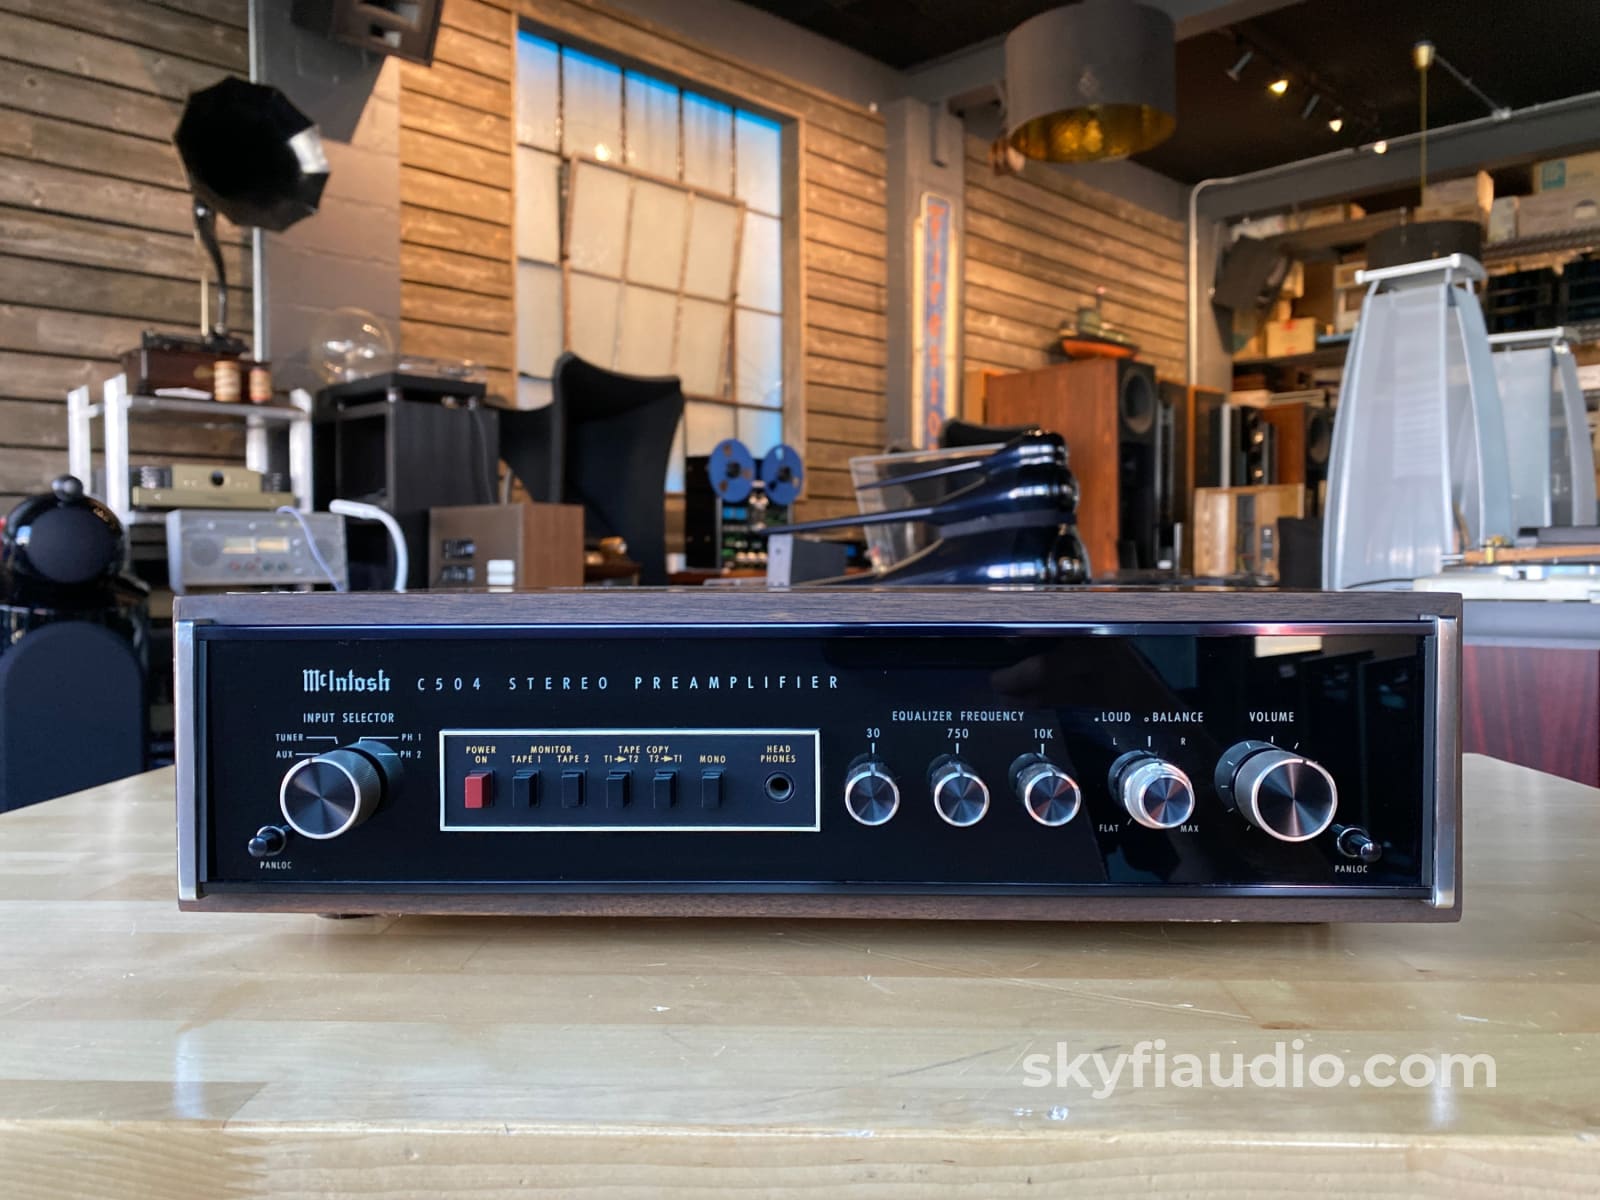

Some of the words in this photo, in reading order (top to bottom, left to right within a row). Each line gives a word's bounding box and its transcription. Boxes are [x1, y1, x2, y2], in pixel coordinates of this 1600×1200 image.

[302, 669, 391, 692] McIntosh
[417, 677, 481, 691] C504
[508, 676, 609, 691] STEREO
[634, 675, 839, 691] PREAMPLIFIER
[303, 712, 335, 723] INPUT
[342, 712, 395, 723] SELECTOR
[892, 710, 953, 722] EQUALIZER
[960, 710, 1025, 722] FREQUENCY
[1102, 711, 1131, 722] LOUD
[1152, 711, 1204, 723] BALANCE
[1249, 711, 1295, 723] VOLUME
[275, 733, 304, 742] TUNER
[401, 733, 413, 742] PH
[418, 733, 422, 742] 1
[866, 727, 881, 739] 30
[947, 727, 969, 739] 750
[1033, 727, 1054, 739] 10K
[1112, 737, 1118, 746] L
[1180, 737, 1187, 746] R
[465, 745, 497, 754] POWER
[530, 745, 572, 754] MONITOR
[618, 745, 641, 754] TAPE
[646, 745, 670, 754] COPY
[766, 745, 791, 754] HEAD
[275, 750, 293, 759] AUX
[400, 750, 412, 759] PH
[416, 750, 422, 759] 2
[557, 755, 579, 763] TAPE
[584, 754, 590, 763] 2
[760, 754, 797, 763] PHONES
[474, 755, 488, 764] ON
[511, 755, 533, 764] TAPE
[699, 755, 727, 764] MONO
[1099, 823, 1119, 833] FLAT
[1180, 823, 1199, 833] MAX
[259, 860, 292, 870] PANLOC
[1334, 864, 1369, 874] PANLOC
